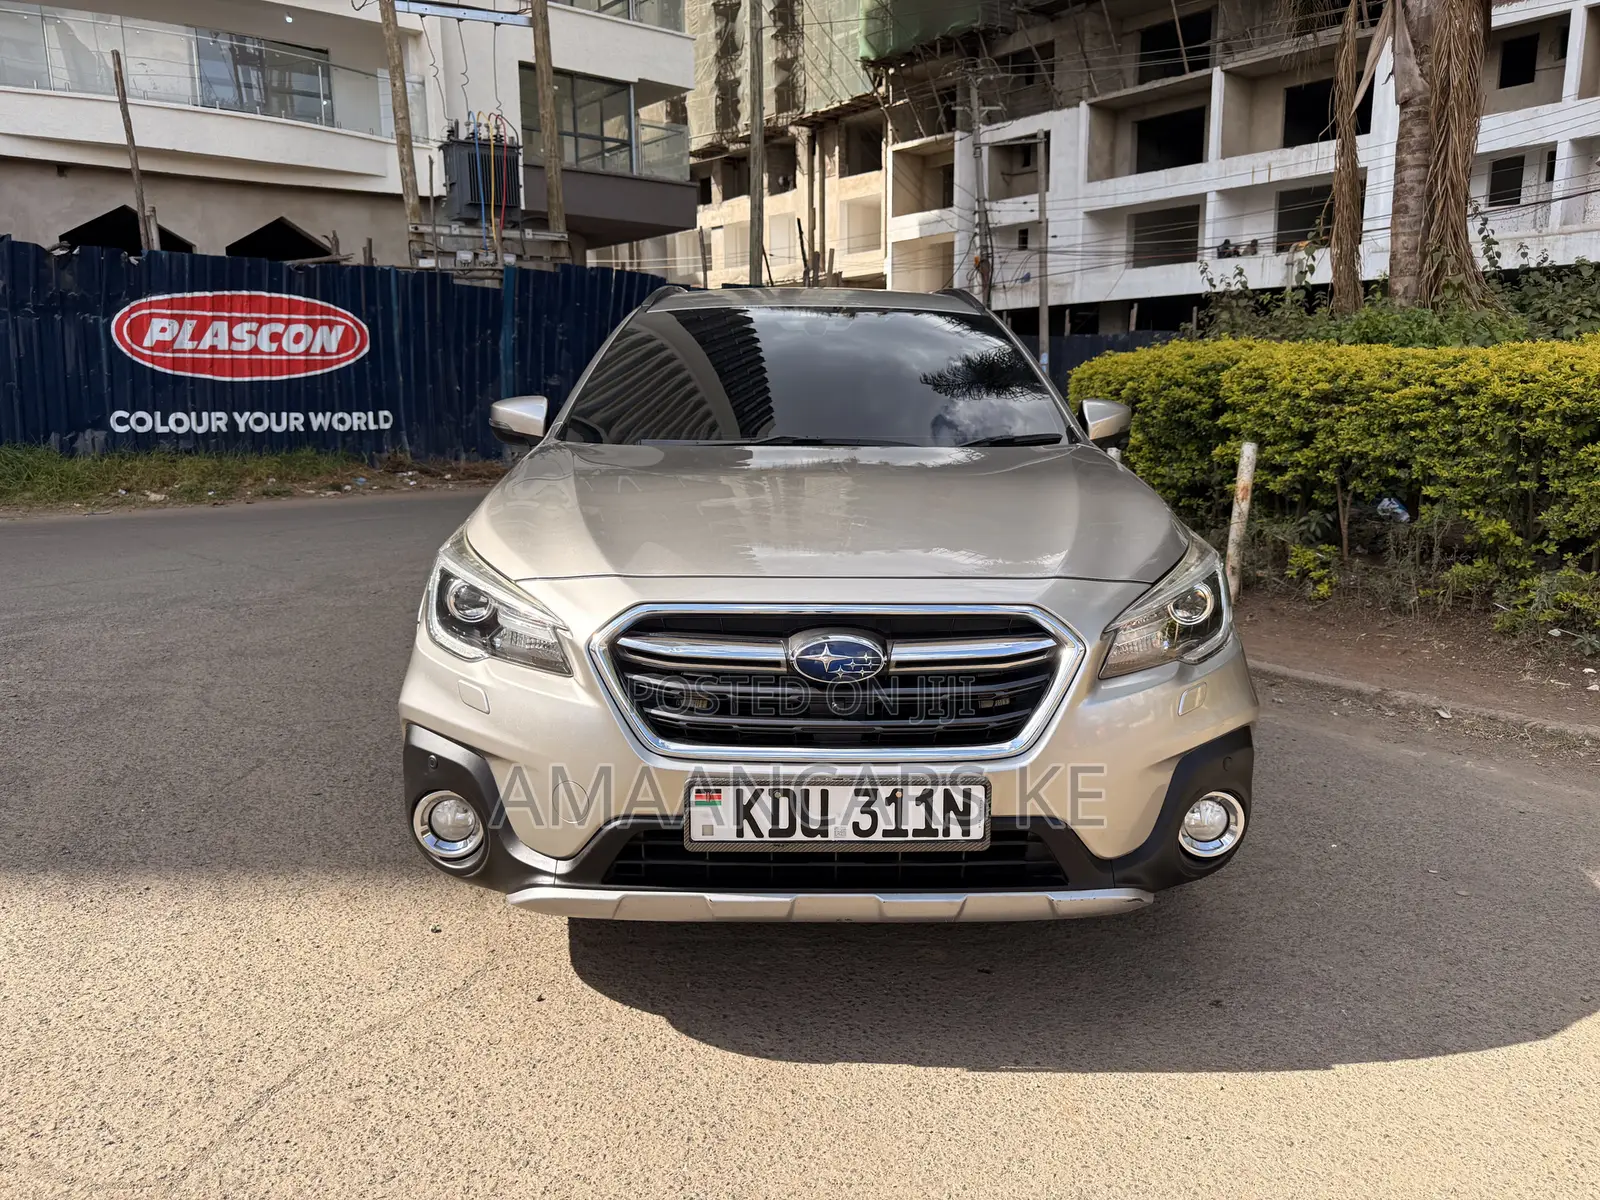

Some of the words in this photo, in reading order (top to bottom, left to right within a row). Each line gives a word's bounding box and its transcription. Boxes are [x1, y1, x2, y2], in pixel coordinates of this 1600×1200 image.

[142, 317, 345, 354] PLASCON
[109, 410, 229, 434] COLOUR
[233, 411, 305, 433] YOUR
[309, 410, 394, 432] WORLD
[735, 788, 830, 839] KDU
[851, 788, 973, 839] 311N
